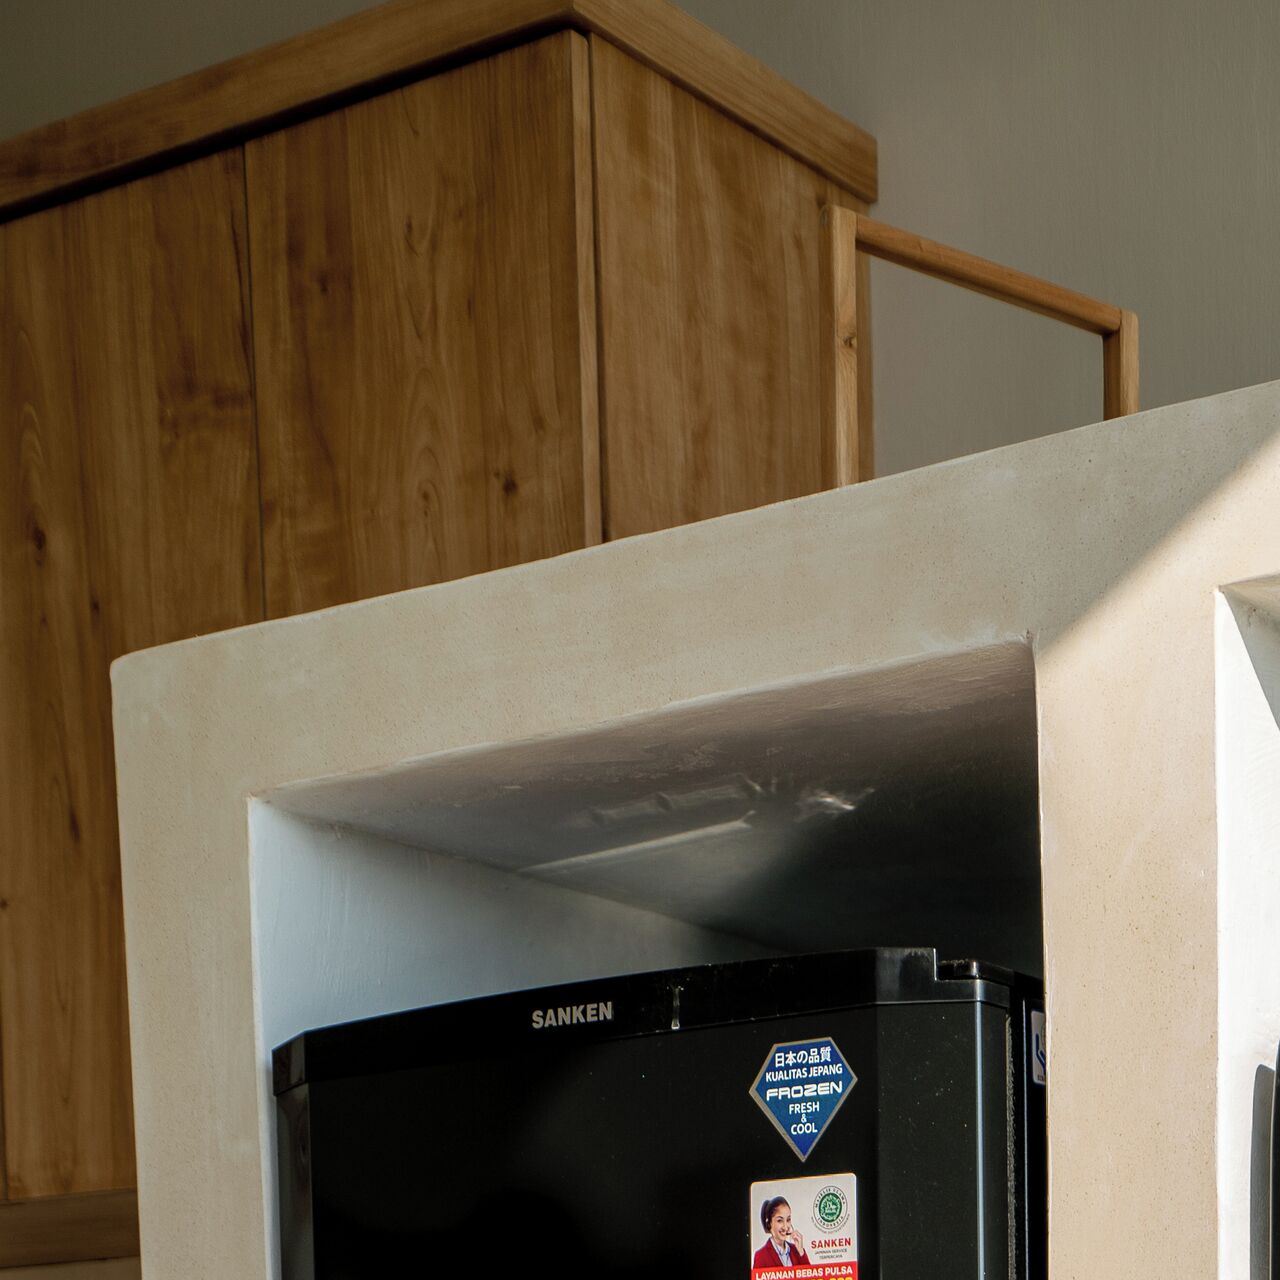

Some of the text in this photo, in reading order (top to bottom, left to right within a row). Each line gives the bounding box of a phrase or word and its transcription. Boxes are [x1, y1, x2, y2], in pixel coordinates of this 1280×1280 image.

[532, 1001, 613, 1029] SANKEN
[775, 1045, 832, 1068] 日本の品質
[765, 1063, 843, 1082] KUALITAS JEPANG
[766, 1080, 843, 1101] FROZEN
[789, 1101, 820, 1115] FRESH
[800, 1114, 807, 1123] &
[791, 1122, 818, 1135] COOL
[811, 1237, 851, 1249] SANKEN
[755, 1265, 853, 1280] LAYANAN BEBAS PULSA
